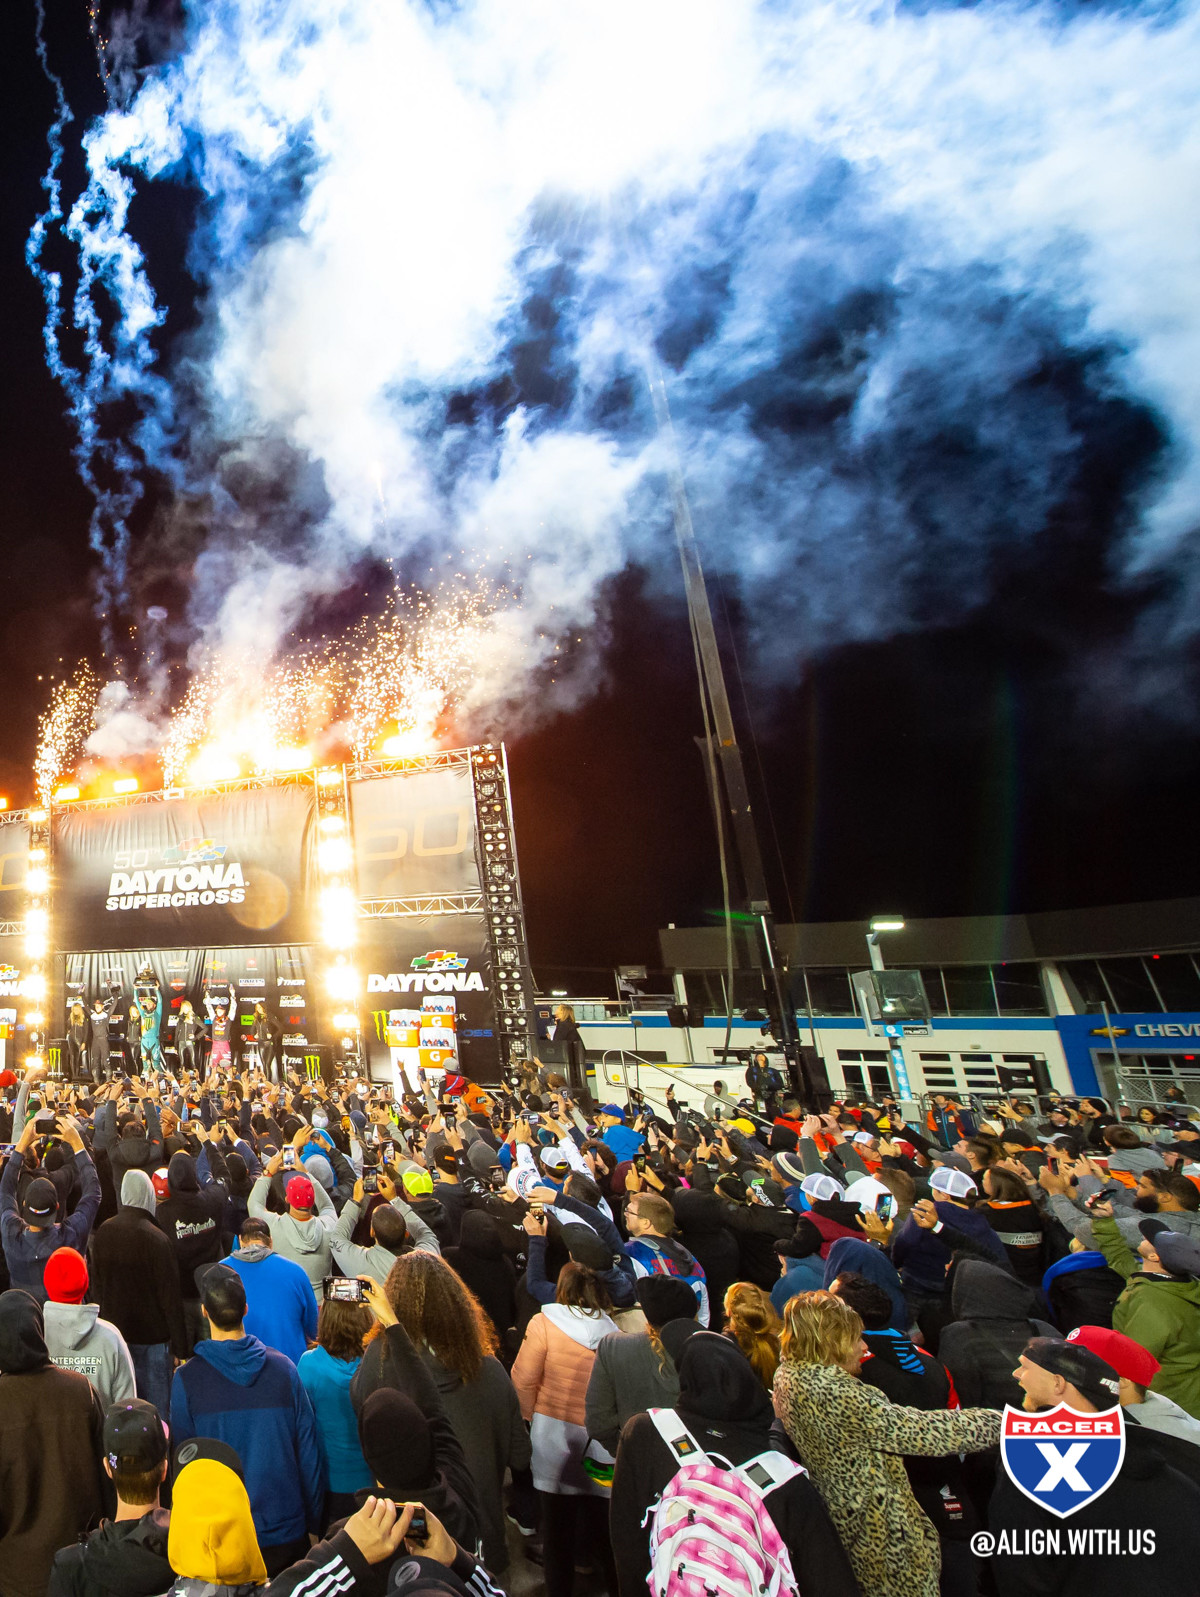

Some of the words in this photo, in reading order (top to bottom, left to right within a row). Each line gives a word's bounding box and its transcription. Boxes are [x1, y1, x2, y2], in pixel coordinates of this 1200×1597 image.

[108, 863, 244, 896] DAYTONA
[105, 888, 246, 911] SUPERCROSS
[367, 972, 485, 993] DAYTONA
